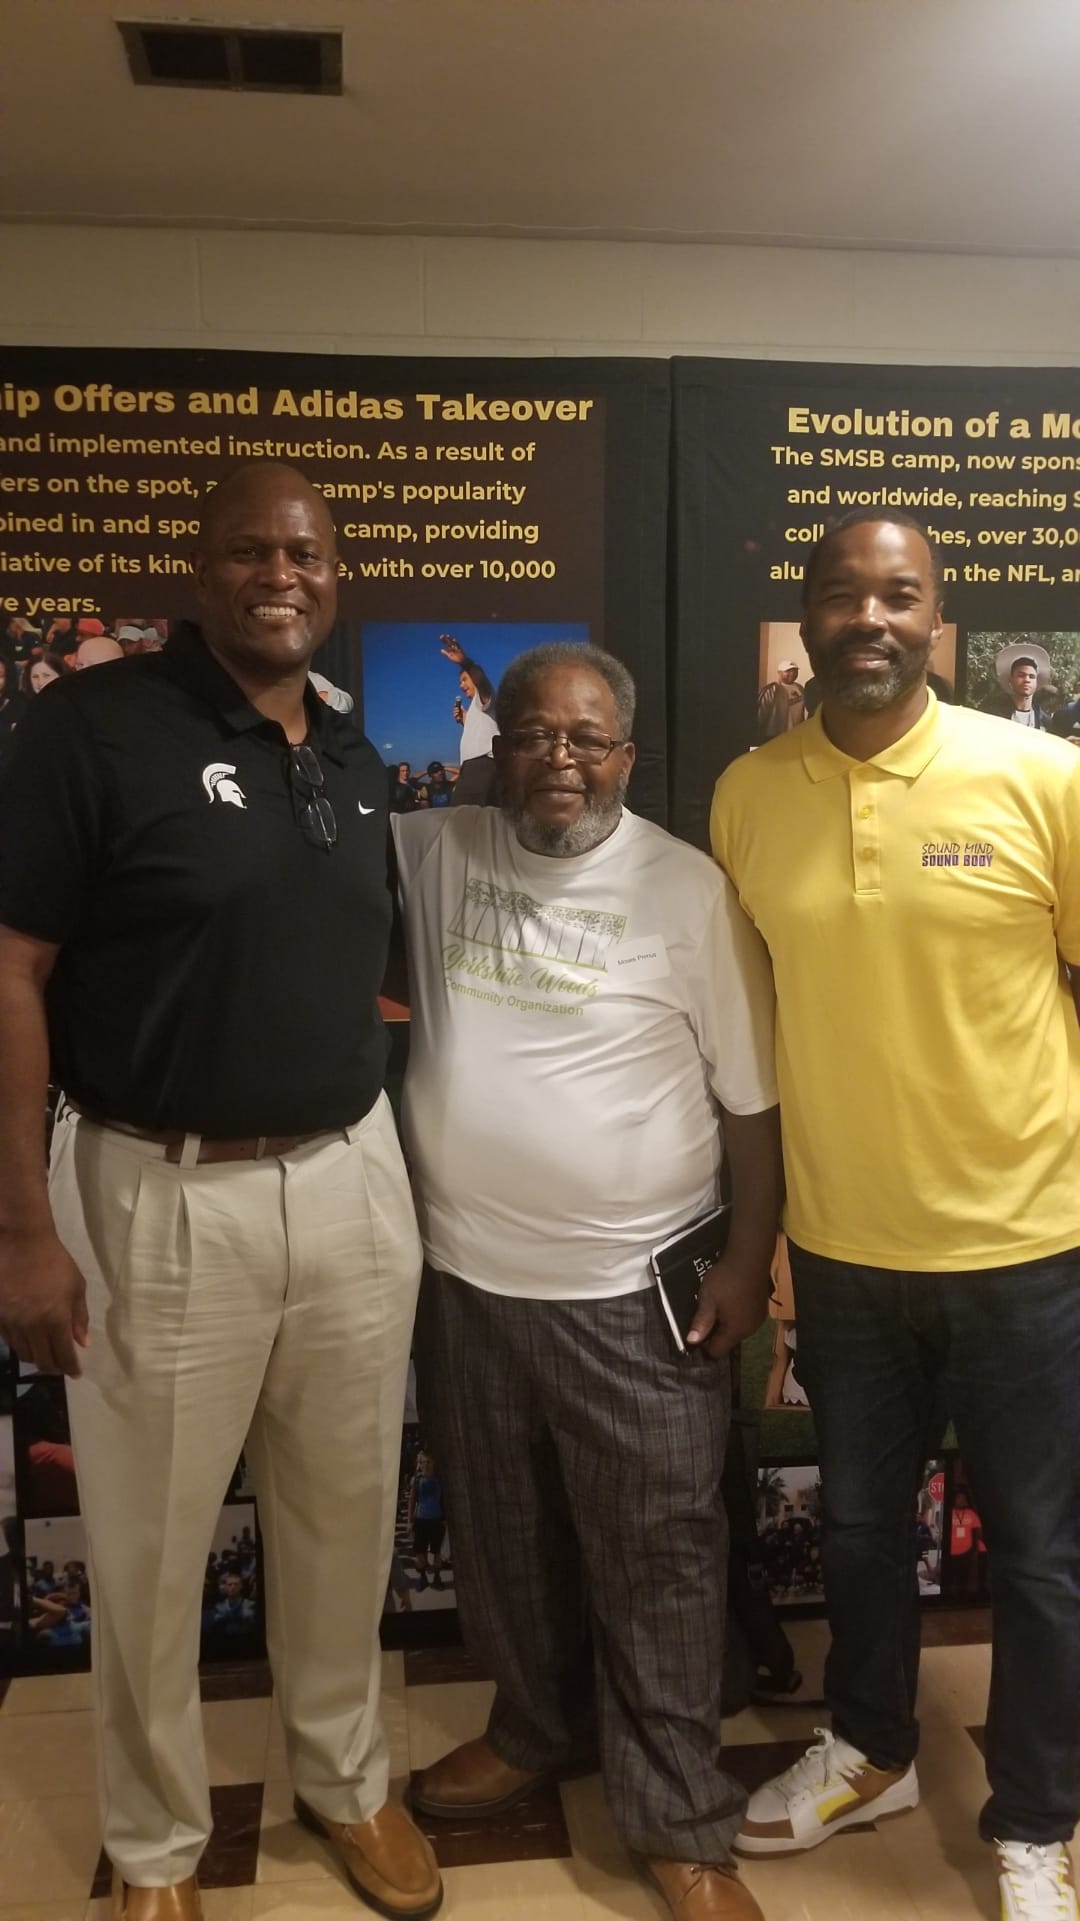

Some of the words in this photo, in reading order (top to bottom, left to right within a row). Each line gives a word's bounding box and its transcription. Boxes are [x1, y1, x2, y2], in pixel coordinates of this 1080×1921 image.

[0, 382, 41, 418] ip
[53, 383, 176, 413] Offers
[188, 387, 259, 415] and
[272, 389, 404, 420] Adidas
[415, 393, 594, 421] Takeover
[787, 407, 953, 437] Evolution
[965, 412, 999, 438] of
[1009, 418, 1031, 439] a
[49, 433, 220, 457] implemented
[229, 435, 371, 459] instruction.
[377, 441, 408, 460] As
[415, 446, 428, 461] a
[436, 442, 505, 461] result
[511, 442, 536, 461] of
[771, 446, 814, 465] The
[820, 449, 885, 468] SMSB
[891, 454, 960, 473] camp,
[967, 455, 1015, 470] now
[0, 476, 40, 492] ers
[47, 477, 79, 493] on
[87, 473, 130, 494] the
[136, 477, 199, 499] spot,
[402, 481, 526, 505] popularity
[787, 486, 830, 504] and
[837, 488, 963, 509] worldwide,
[969, 488, 1067, 512] reaching
[72, 513, 95, 532] in
[103, 515, 150, 534] and
[343, 523, 418, 543] camp,
[425, 520, 539, 544] providing
[977, 530, 1026, 545] over
[78, 554, 104, 573] of
[111, 553, 141, 573] its
[360, 558, 414, 577] with
[421, 563, 474, 578] over
[480, 560, 556, 582] 10,000
[964, 565, 1000, 582] the
[1008, 565, 1055, 585] NFL,
[25, 597, 102, 616] years.
[921, 843, 960, 855] SOUND
[964, 842, 994, 855] MIND
[921, 854, 959, 867] SOUND
[963, 854, 993, 867] BODY
[530, 967, 600, 999] Woods
[507, 995, 584, 1017] Organization
